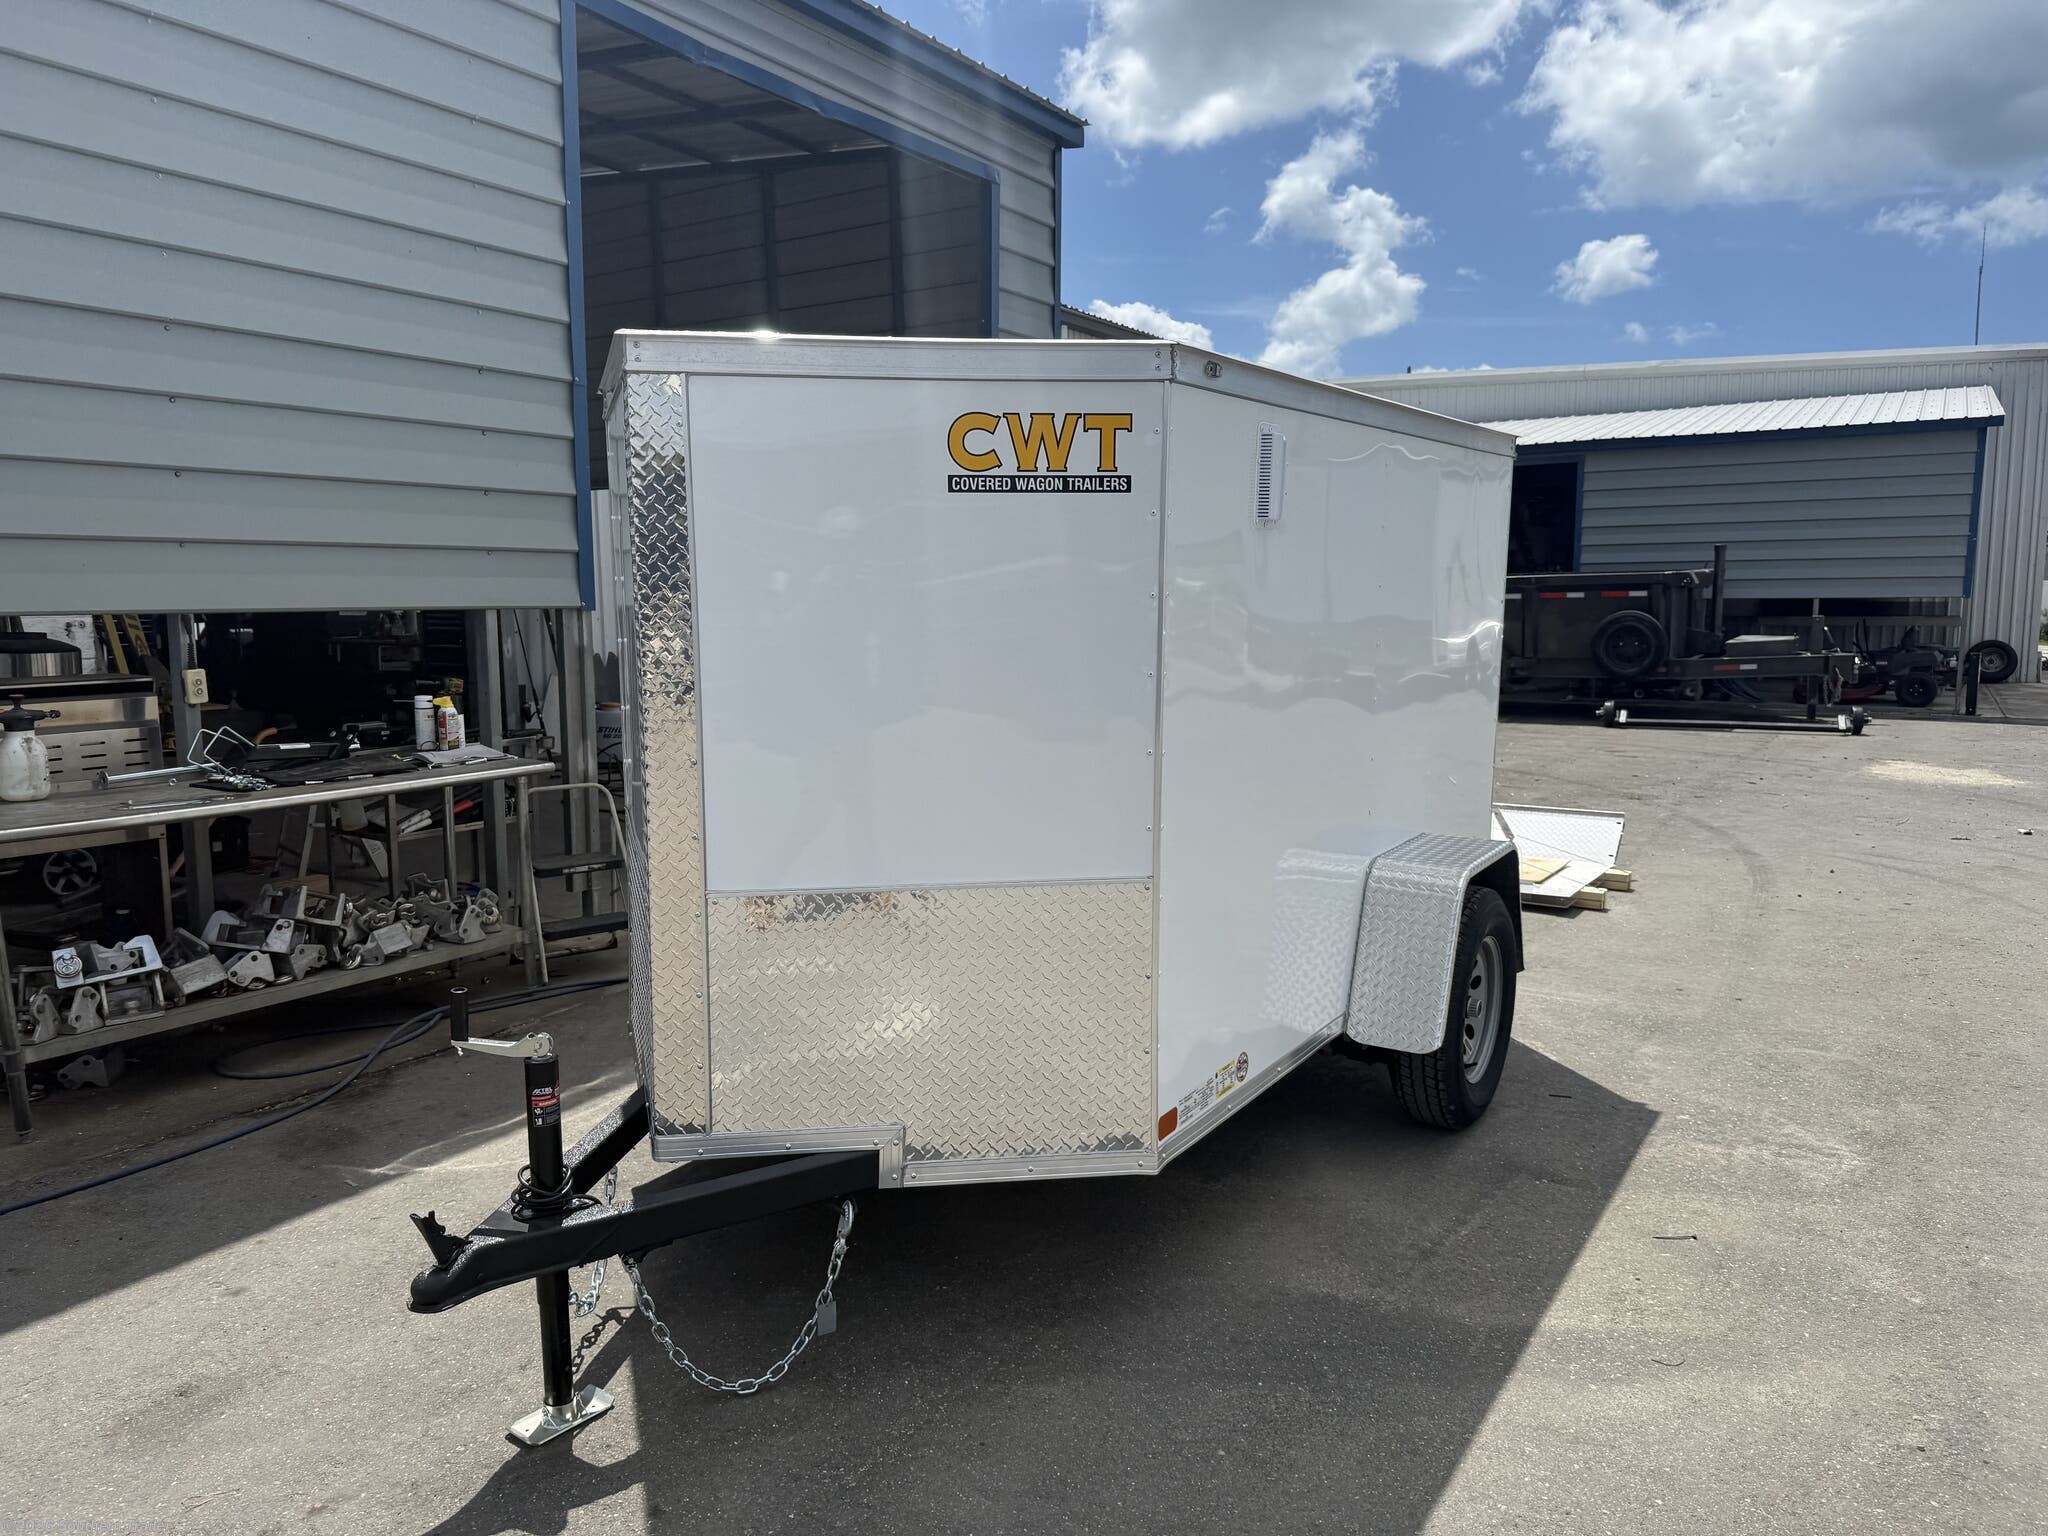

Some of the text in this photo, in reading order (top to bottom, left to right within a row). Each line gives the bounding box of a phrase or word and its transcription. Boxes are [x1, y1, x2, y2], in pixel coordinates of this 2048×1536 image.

[948, 412, 1132, 472] CWT
[952, 477, 1128, 491] COVERED WAGON TRAILERS
